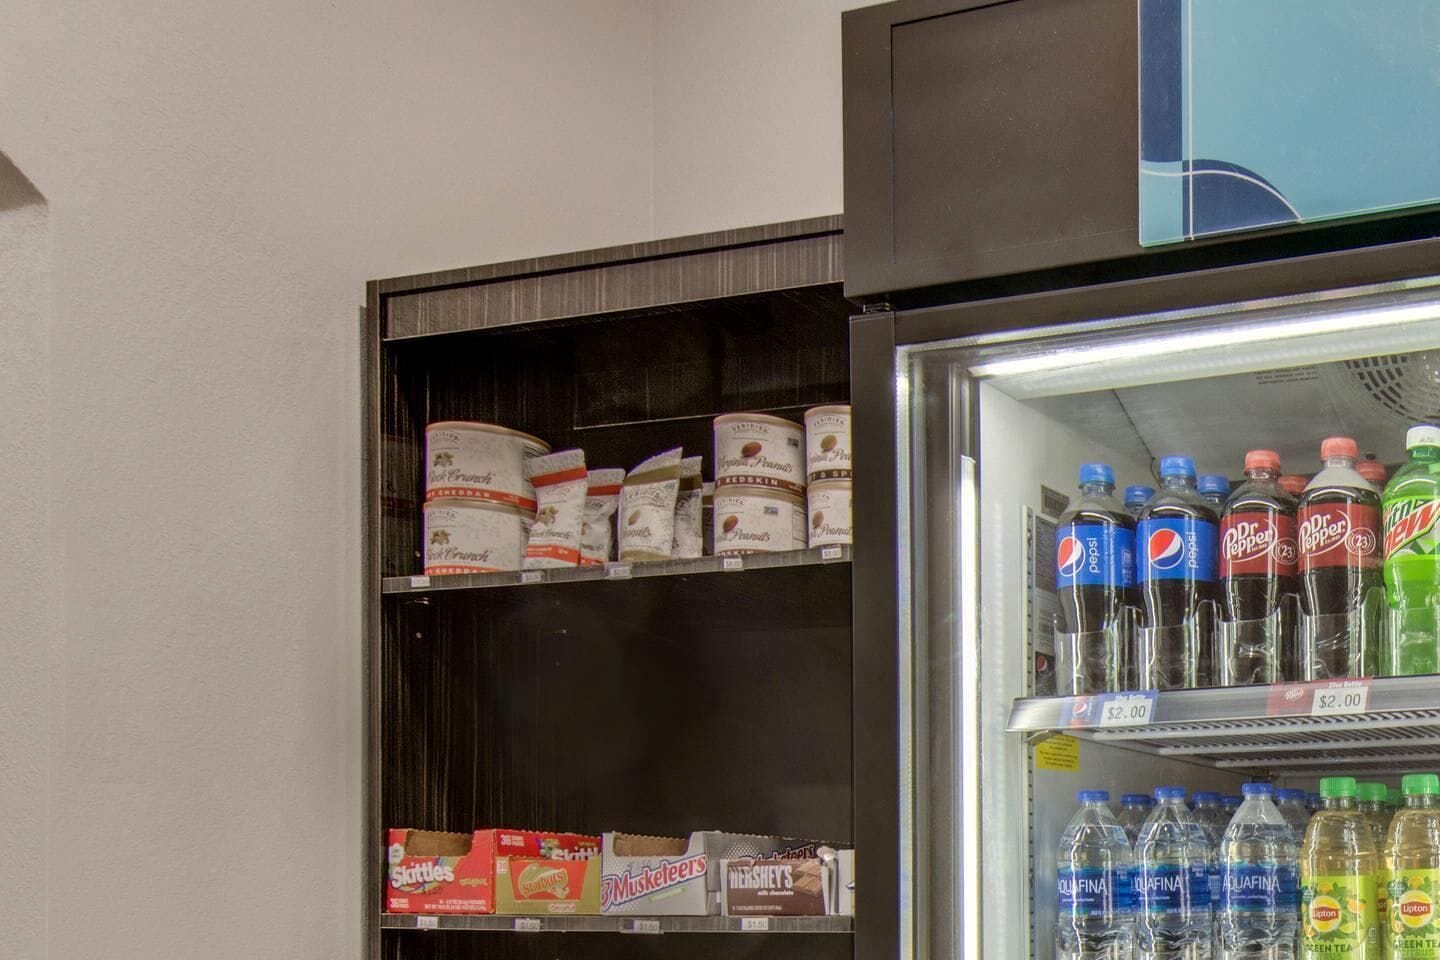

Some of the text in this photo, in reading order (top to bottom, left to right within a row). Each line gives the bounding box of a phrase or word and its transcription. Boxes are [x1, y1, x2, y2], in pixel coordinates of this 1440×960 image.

[750, 456, 792, 473] Peanuts
[450, 469, 493, 484] Crunch
[726, 477, 778, 486] REDSKIN
[1238, 522, 1258, 540] Dr
[1310, 514, 1331, 533] Dr
[730, 529, 770, 542] Peanuts
[1226, 527, 1273, 559] Pepper
[1300, 518, 1346, 554] Pepper
[1353, 533, 1368, 549] 23
[445, 547, 490, 562] Crunch
[1088, 537, 1101, 573] pepsi
[1188, 531, 1200, 569] pepsi
[1278, 544, 1293, 558] 23
[1319, 693, 1361, 709] $2.00
[1107, 705, 1146, 720] $2.00
[391, 863, 454, 888] Skittles
[522, 869, 568, 894] Starburst
[613, 854, 707, 903] Musketeers
[730, 864, 793, 889] HERSHEY'S
[1223, 876, 1281, 896] AQUAFINA
[1402, 904, 1428, 914] Lipton
[1334, 944, 1353, 953] TEA
